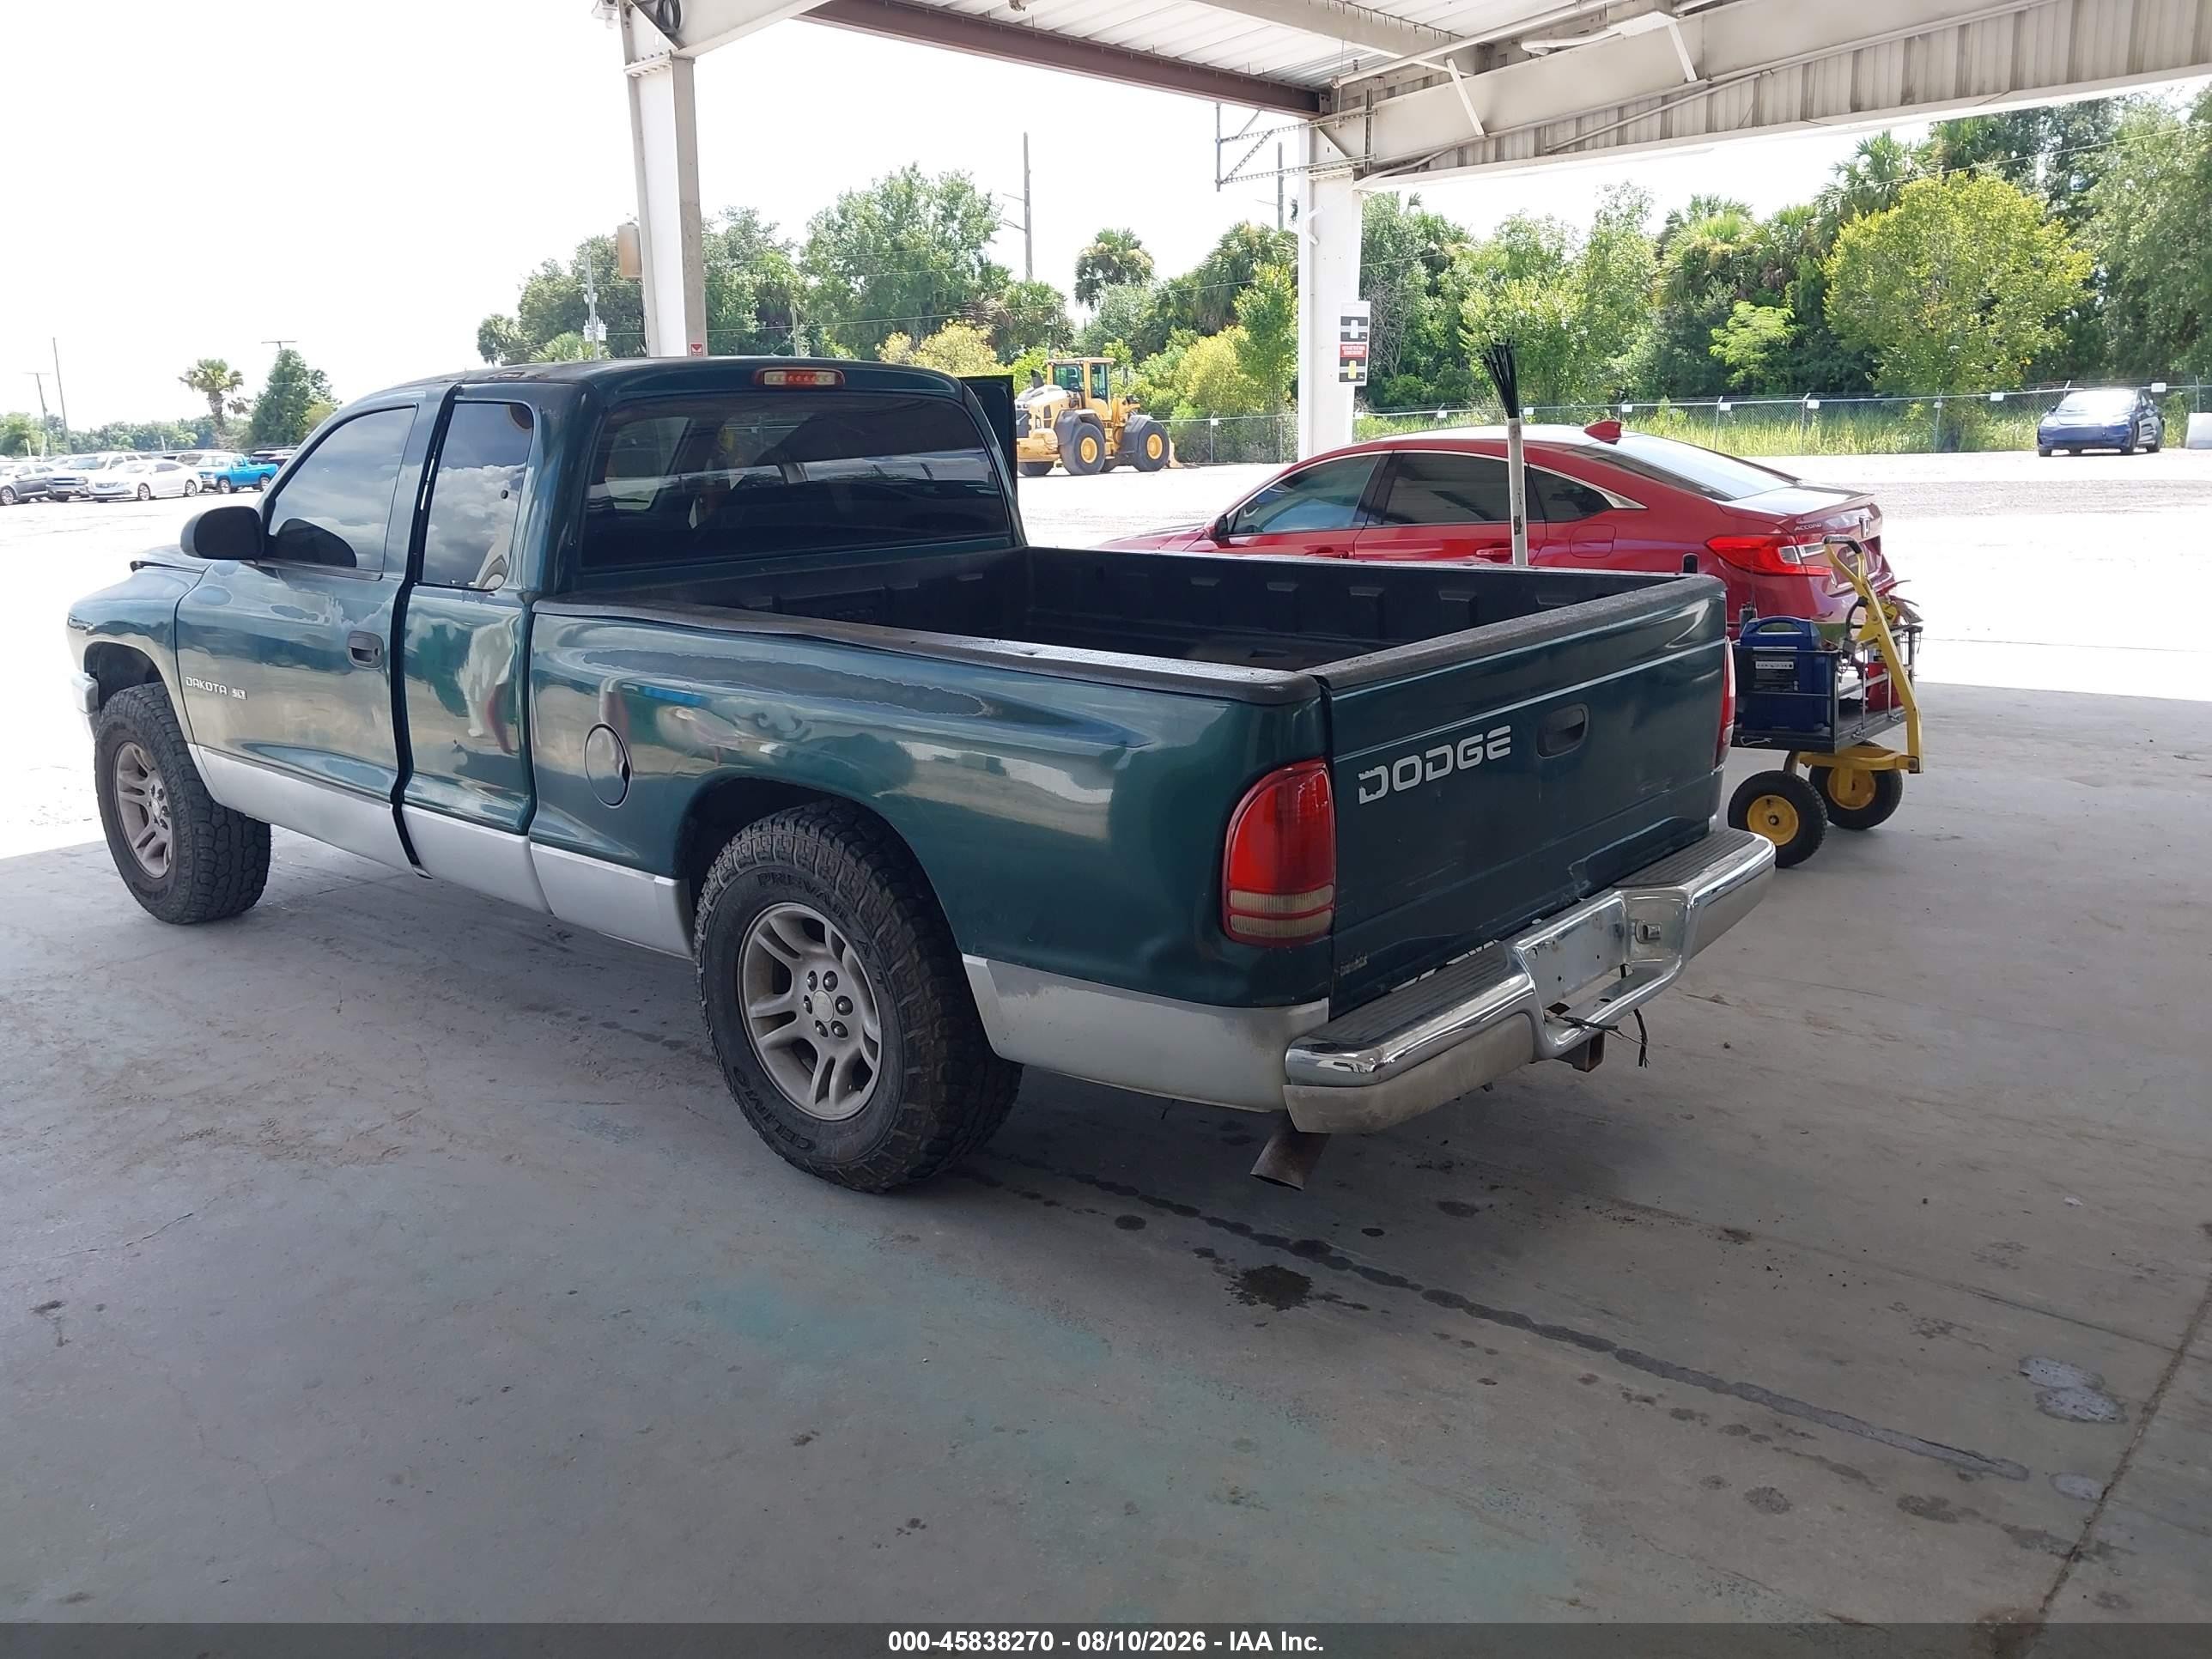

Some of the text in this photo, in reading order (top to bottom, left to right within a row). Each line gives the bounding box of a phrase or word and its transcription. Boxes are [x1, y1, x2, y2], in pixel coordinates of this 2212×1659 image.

[1794, 522, 1822, 532] ACCORD
[185, 676, 228, 696] DAKOTA
[1358, 725, 1511, 805] DODGE
